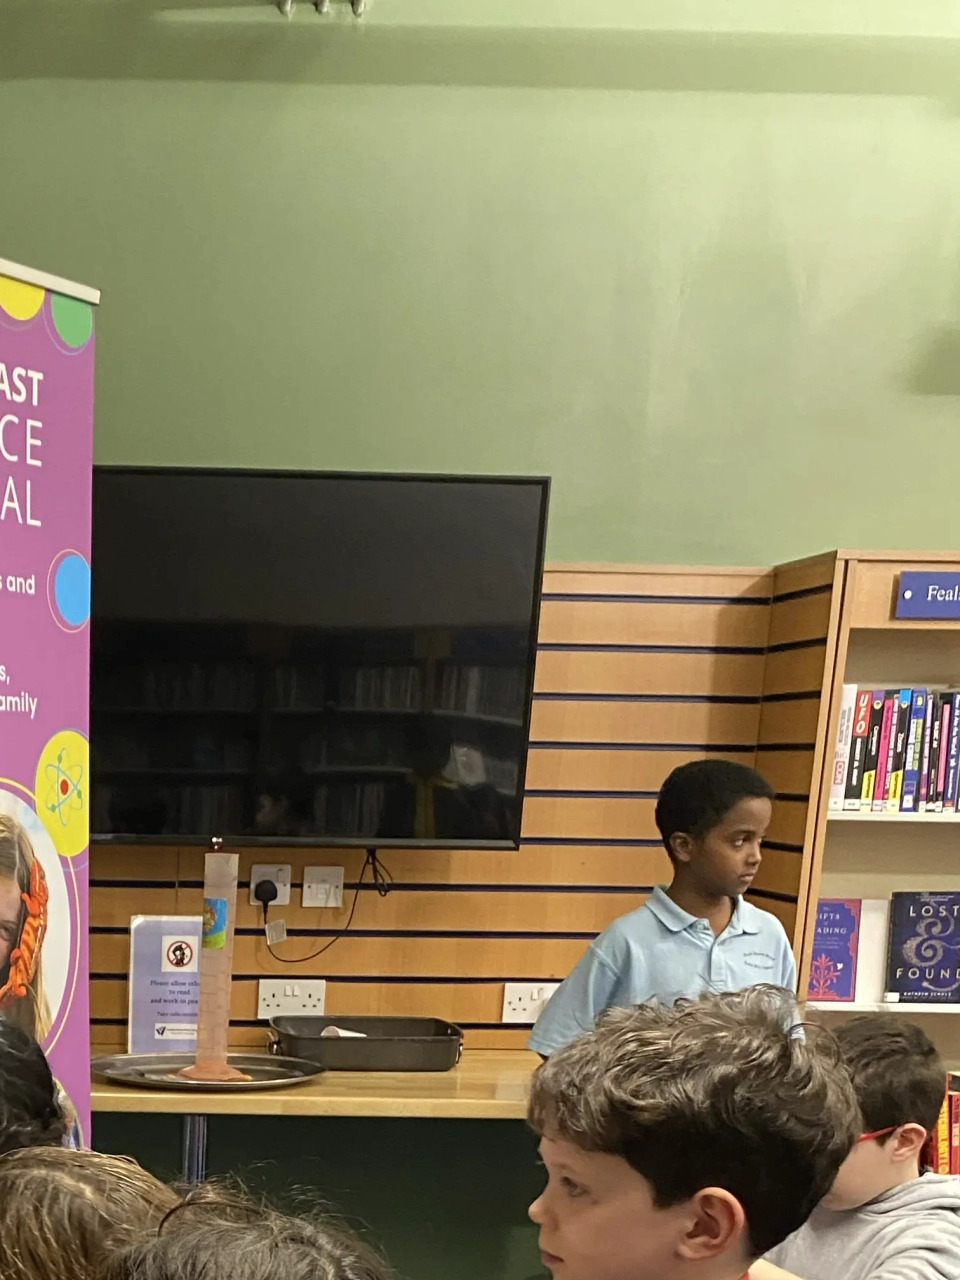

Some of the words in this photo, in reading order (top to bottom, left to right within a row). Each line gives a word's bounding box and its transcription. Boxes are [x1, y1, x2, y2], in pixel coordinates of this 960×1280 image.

[6, 574, 35, 595] and
[926, 584, 960, 602] Feal
[855, 694, 869, 734] UFO
[835, 763, 845, 784] CON
[818, 912, 841, 920] IFTS
[909, 905, 960, 918] LOST
[815, 926, 847, 935] ADING
